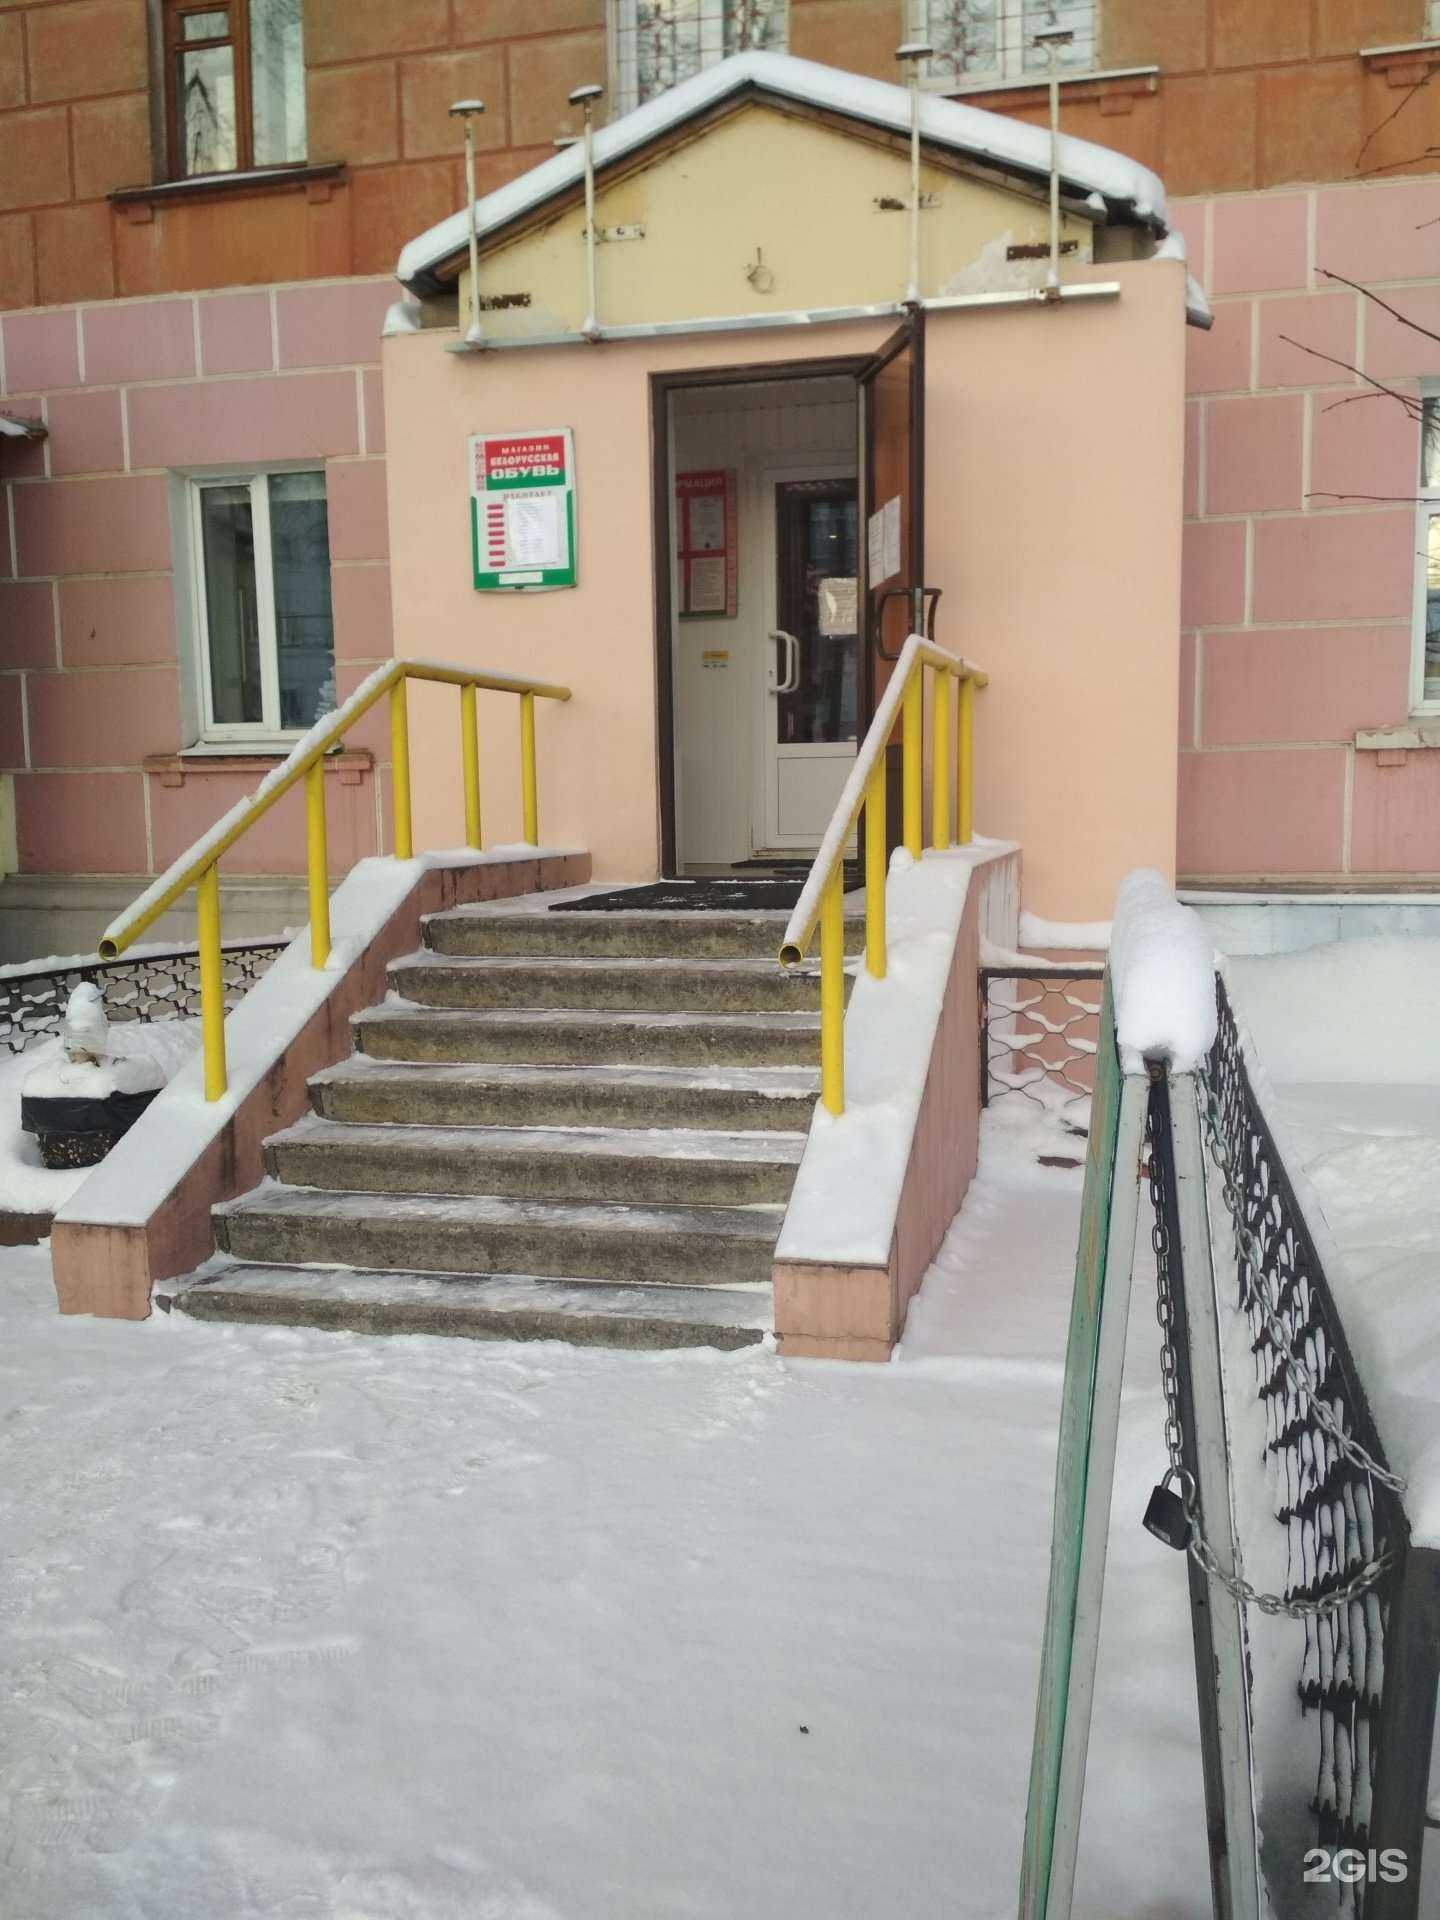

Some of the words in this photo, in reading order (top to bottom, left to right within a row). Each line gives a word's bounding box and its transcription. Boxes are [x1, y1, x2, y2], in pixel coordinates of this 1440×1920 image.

[501, 445, 550, 454] МАГАЗИН
[490, 453, 560, 466] БЕЛОРУССКАЯ
[491, 464, 560, 480] ОБУВЬ
